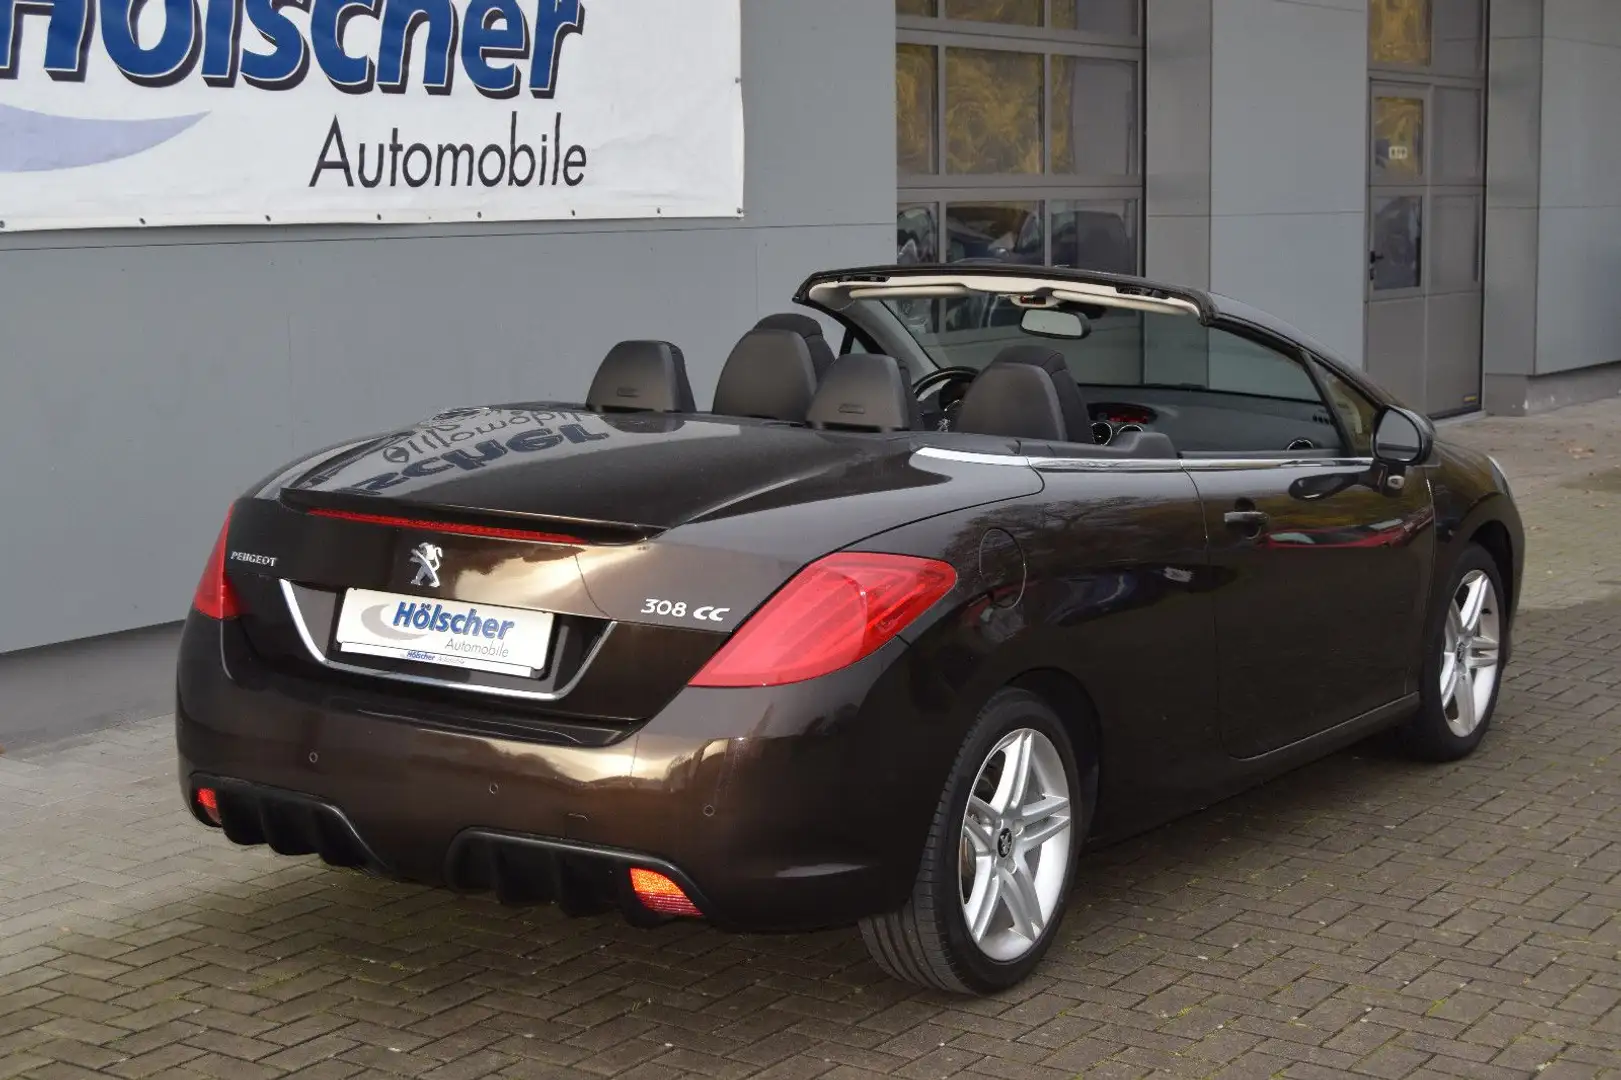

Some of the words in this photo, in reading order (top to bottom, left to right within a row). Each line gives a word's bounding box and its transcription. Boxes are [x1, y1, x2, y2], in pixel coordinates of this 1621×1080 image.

[308, 110, 587, 188] Automobile
[230, 550, 277, 567] PEUGEOT
[392, 601, 515, 640] Hölscher
[640, 598, 687, 617] 308
[693, 606, 731, 622] CC
[406, 650, 436, 661] Hölscher
[444, 638, 509, 658] Automobile
